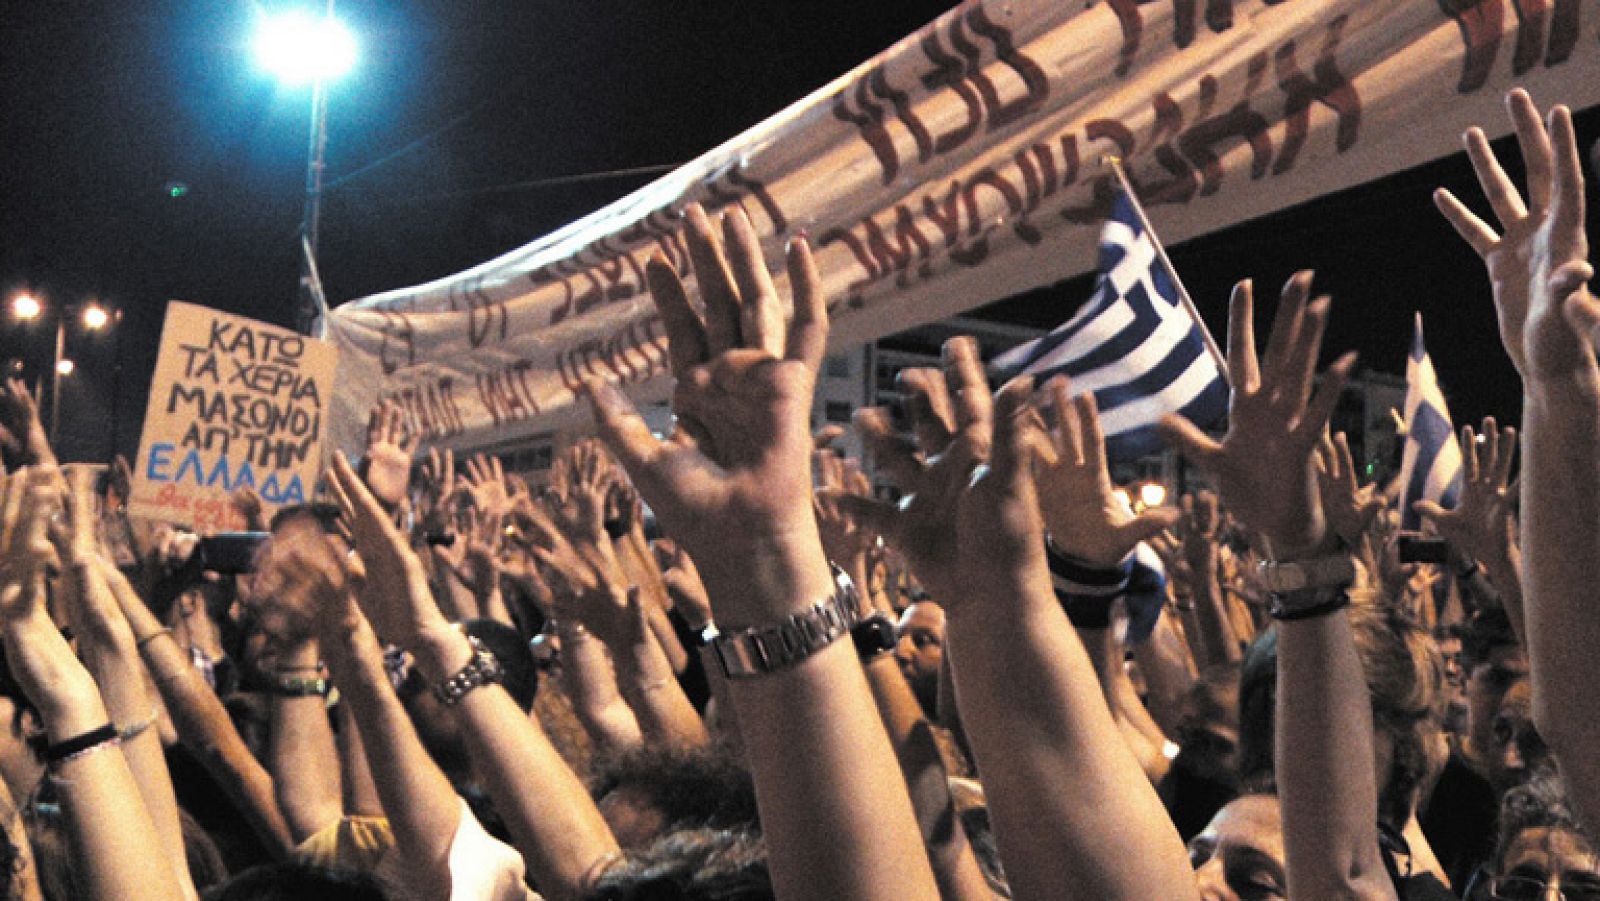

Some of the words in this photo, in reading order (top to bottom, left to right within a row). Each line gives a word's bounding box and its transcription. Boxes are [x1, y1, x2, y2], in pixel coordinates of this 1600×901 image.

[209, 319, 304, 367] ΚΑΤΩ
[179, 343, 219, 384] ΤΑ
[229, 357, 321, 409] ΧΕΡΙΑ
[167, 381, 320, 443] ΜΑΣΟΝΟΙ
[146, 443, 305, 505] ΕΛΛΑΔΑ
